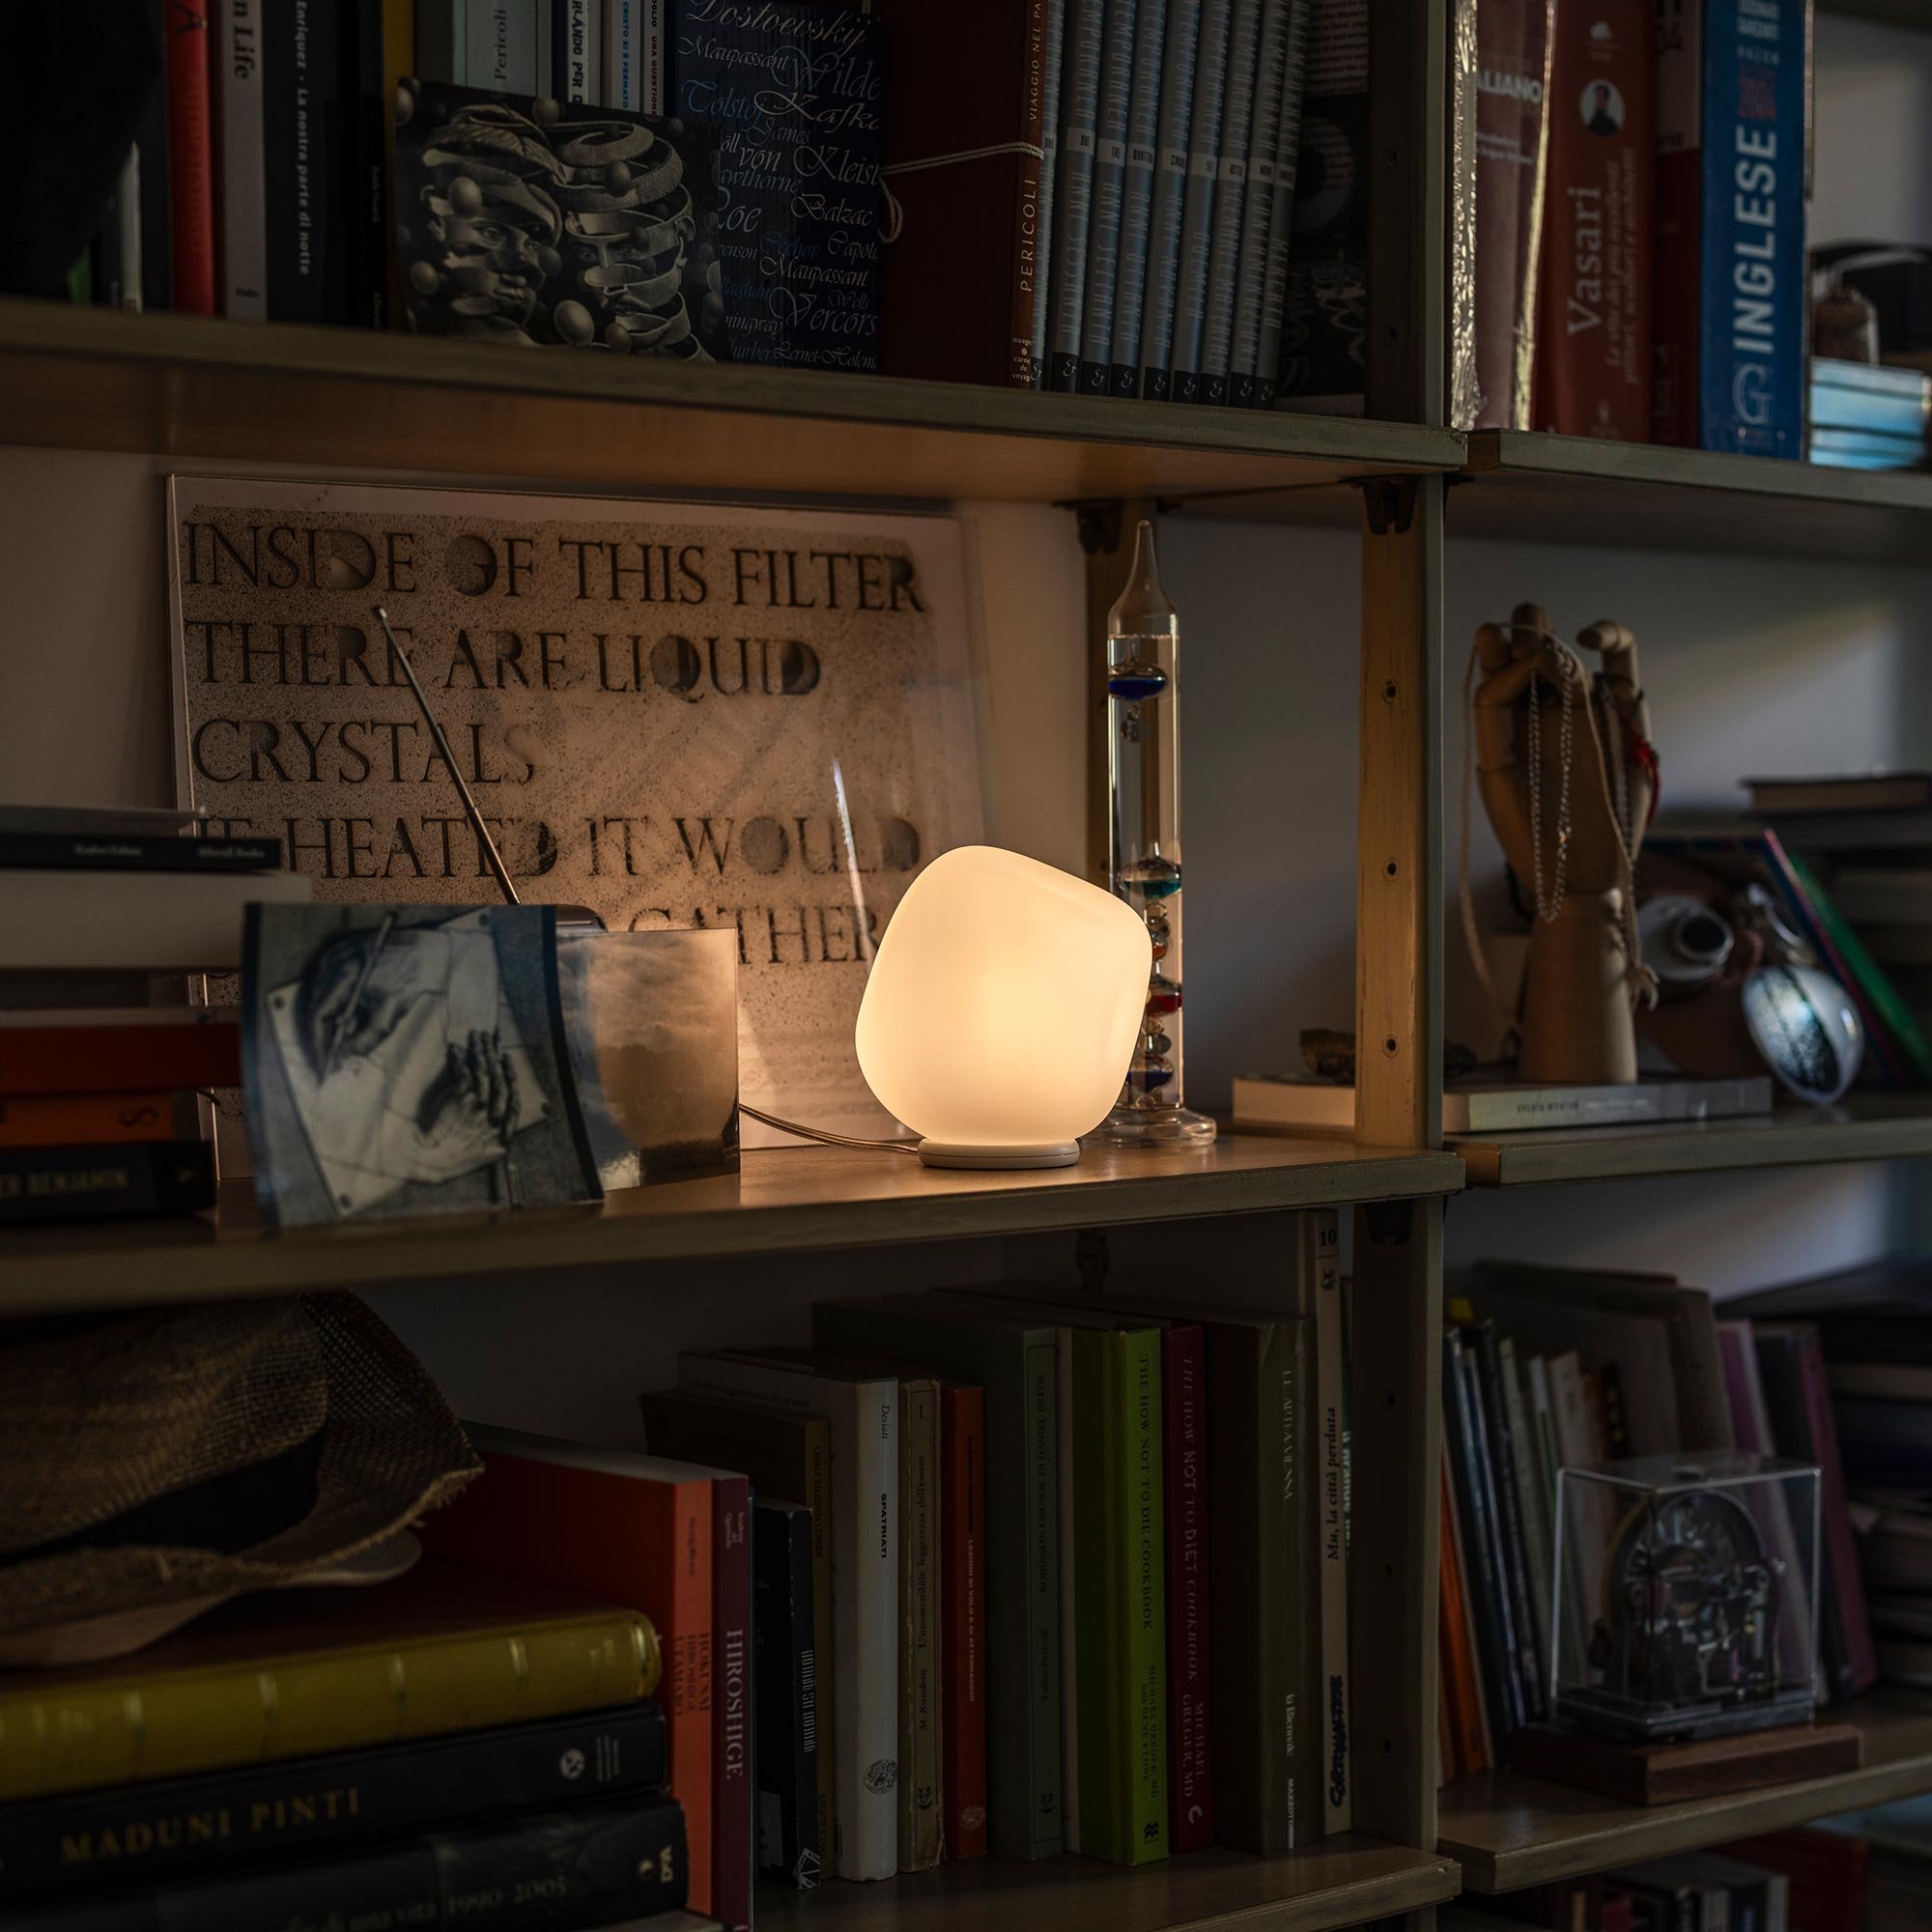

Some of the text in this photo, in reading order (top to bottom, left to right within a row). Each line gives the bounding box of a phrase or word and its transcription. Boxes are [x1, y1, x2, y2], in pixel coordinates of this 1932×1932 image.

[233, 26, 256, 80] Life
[493, 9, 507, 80] Pericoli
[622, 41, 630, 50] SI
[678, 35, 788, 70] Maupassant
[1032, 27, 1041, 53] NEL
[572, 62, 583, 87] PER
[771, 45, 881, 101] Wilde
[1029, 60, 1040, 121] VIAGGIO
[294, 0, 312, 275] Enriquez La nostra parte di notte
[720, 132, 741, 154] öll
[738, 146, 781, 173] von
[742, 117, 811, 146] James
[1111, 146, 1122, 159] TRE
[793, 145, 880, 186] Kleist
[790, 193, 874, 227] Balzac
[1019, 179, 1036, 293] PERICOLI
[1218, 185, 1244, 259] SCENARI
[1060, 172, 1093, 335] ANNI SESSANTA
[1089, 182, 1122, 347] ANNI SETTANTA
[1120, 190, 1151, 344] ANNI OTTANTA
[1566, 185, 1604, 336] Vasari
[1732, 125, 1777, 355] INGLESE
[759, 253, 869, 289] Maupassant
[1153, 194, 1183, 350] ANNI NOVANTA
[1184, 231, 1210, 321] DUEMILA
[1238, 192, 1272, 365] CONTAMINAZIONI
[1264, 238, 1291, 331] MERCATO
[769, 287, 879, 336] Vercors
[1207, 278, 1236, 372] MATERIALI
[185, 522, 924, 612] INSIDE OF THIS FILTER
[185, 620, 821, 703] THERE ARE LIQUID
[192, 719, 536, 785] CRYSTALS
[283, 815, 922, 880] HEATED IT WOULD
[1319, 1229, 1337, 1247] 10
[881, 1405, 890, 1440] Desiati
[1036, 1418, 1046, 1461] DANIEL
[1283, 1397, 1293, 1428] ARTI
[916, 1455, 926, 1508] dell'essere
[1138, 1354, 1153, 1631] THE HOW NOT TO DIE COOKBOOK
[1283, 1444, 1293, 1500] VIENNA
[1323, 1406, 1341, 1561] Mu, la città perduta
[1037, 1479, 1047, 1528] CRUSOE
[1181, 1356, 1200, 1682] THE HOW NOT TO DIET COOKBOOK
[917, 1512, 928, 1567] leggerezza
[1037, 1530, 1048, 1593] ROBINSON
[917, 1570, 927, 1649] L'insostenibile
[968, 1578, 975, 1588] DI
[968, 1625, 975, 1635] DI
[699, 1633, 711, 1713] HOKUSAI
[919, 1667, 928, 1714] Kundera
[1149, 1665, 1158, 1720] MICHAEL
[724, 1629, 745, 1780] HIROSHIGE
[1286, 1692, 1296, 1757] la Biennale
[1142, 1743, 1151, 1783] STONE
[1194, 1700, 1206, 1779] MICHAEL
[250, 1786, 359, 1835] PINTI
[1151, 1780, 1158, 1799] MD
[1183, 1771, 1194, 1798] MD
